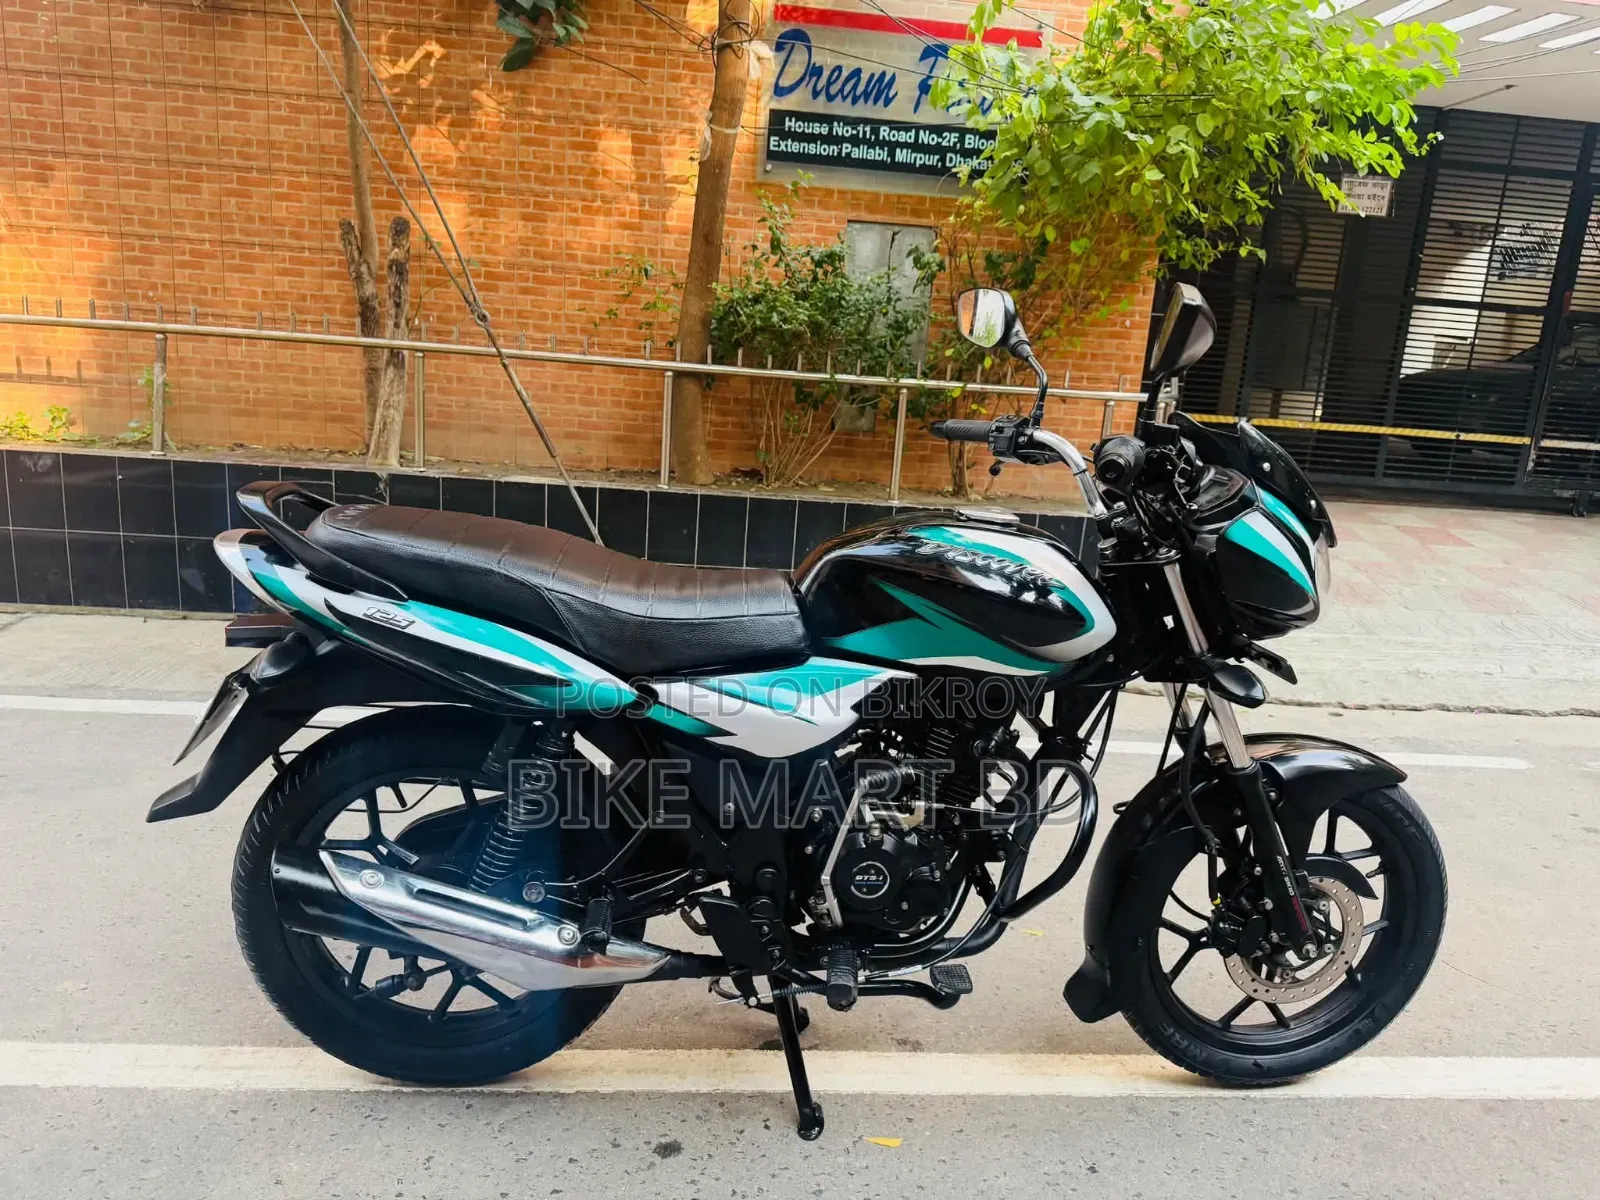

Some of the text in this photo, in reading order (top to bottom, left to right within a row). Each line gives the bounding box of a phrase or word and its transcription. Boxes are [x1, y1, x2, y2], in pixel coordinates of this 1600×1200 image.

[773, 28, 898, 109] Dream
[784, 116, 829, 135] House
[832, 120, 875, 142] No-11,
[879, 126, 915, 143] Road
[918, 129, 961, 149] No-2F,
[769, 136, 838, 157] Extension
[841, 142, 891, 164] Pallabi,
[895, 147, 942, 169] Mirpur,
[362, 606, 416, 630] 125
